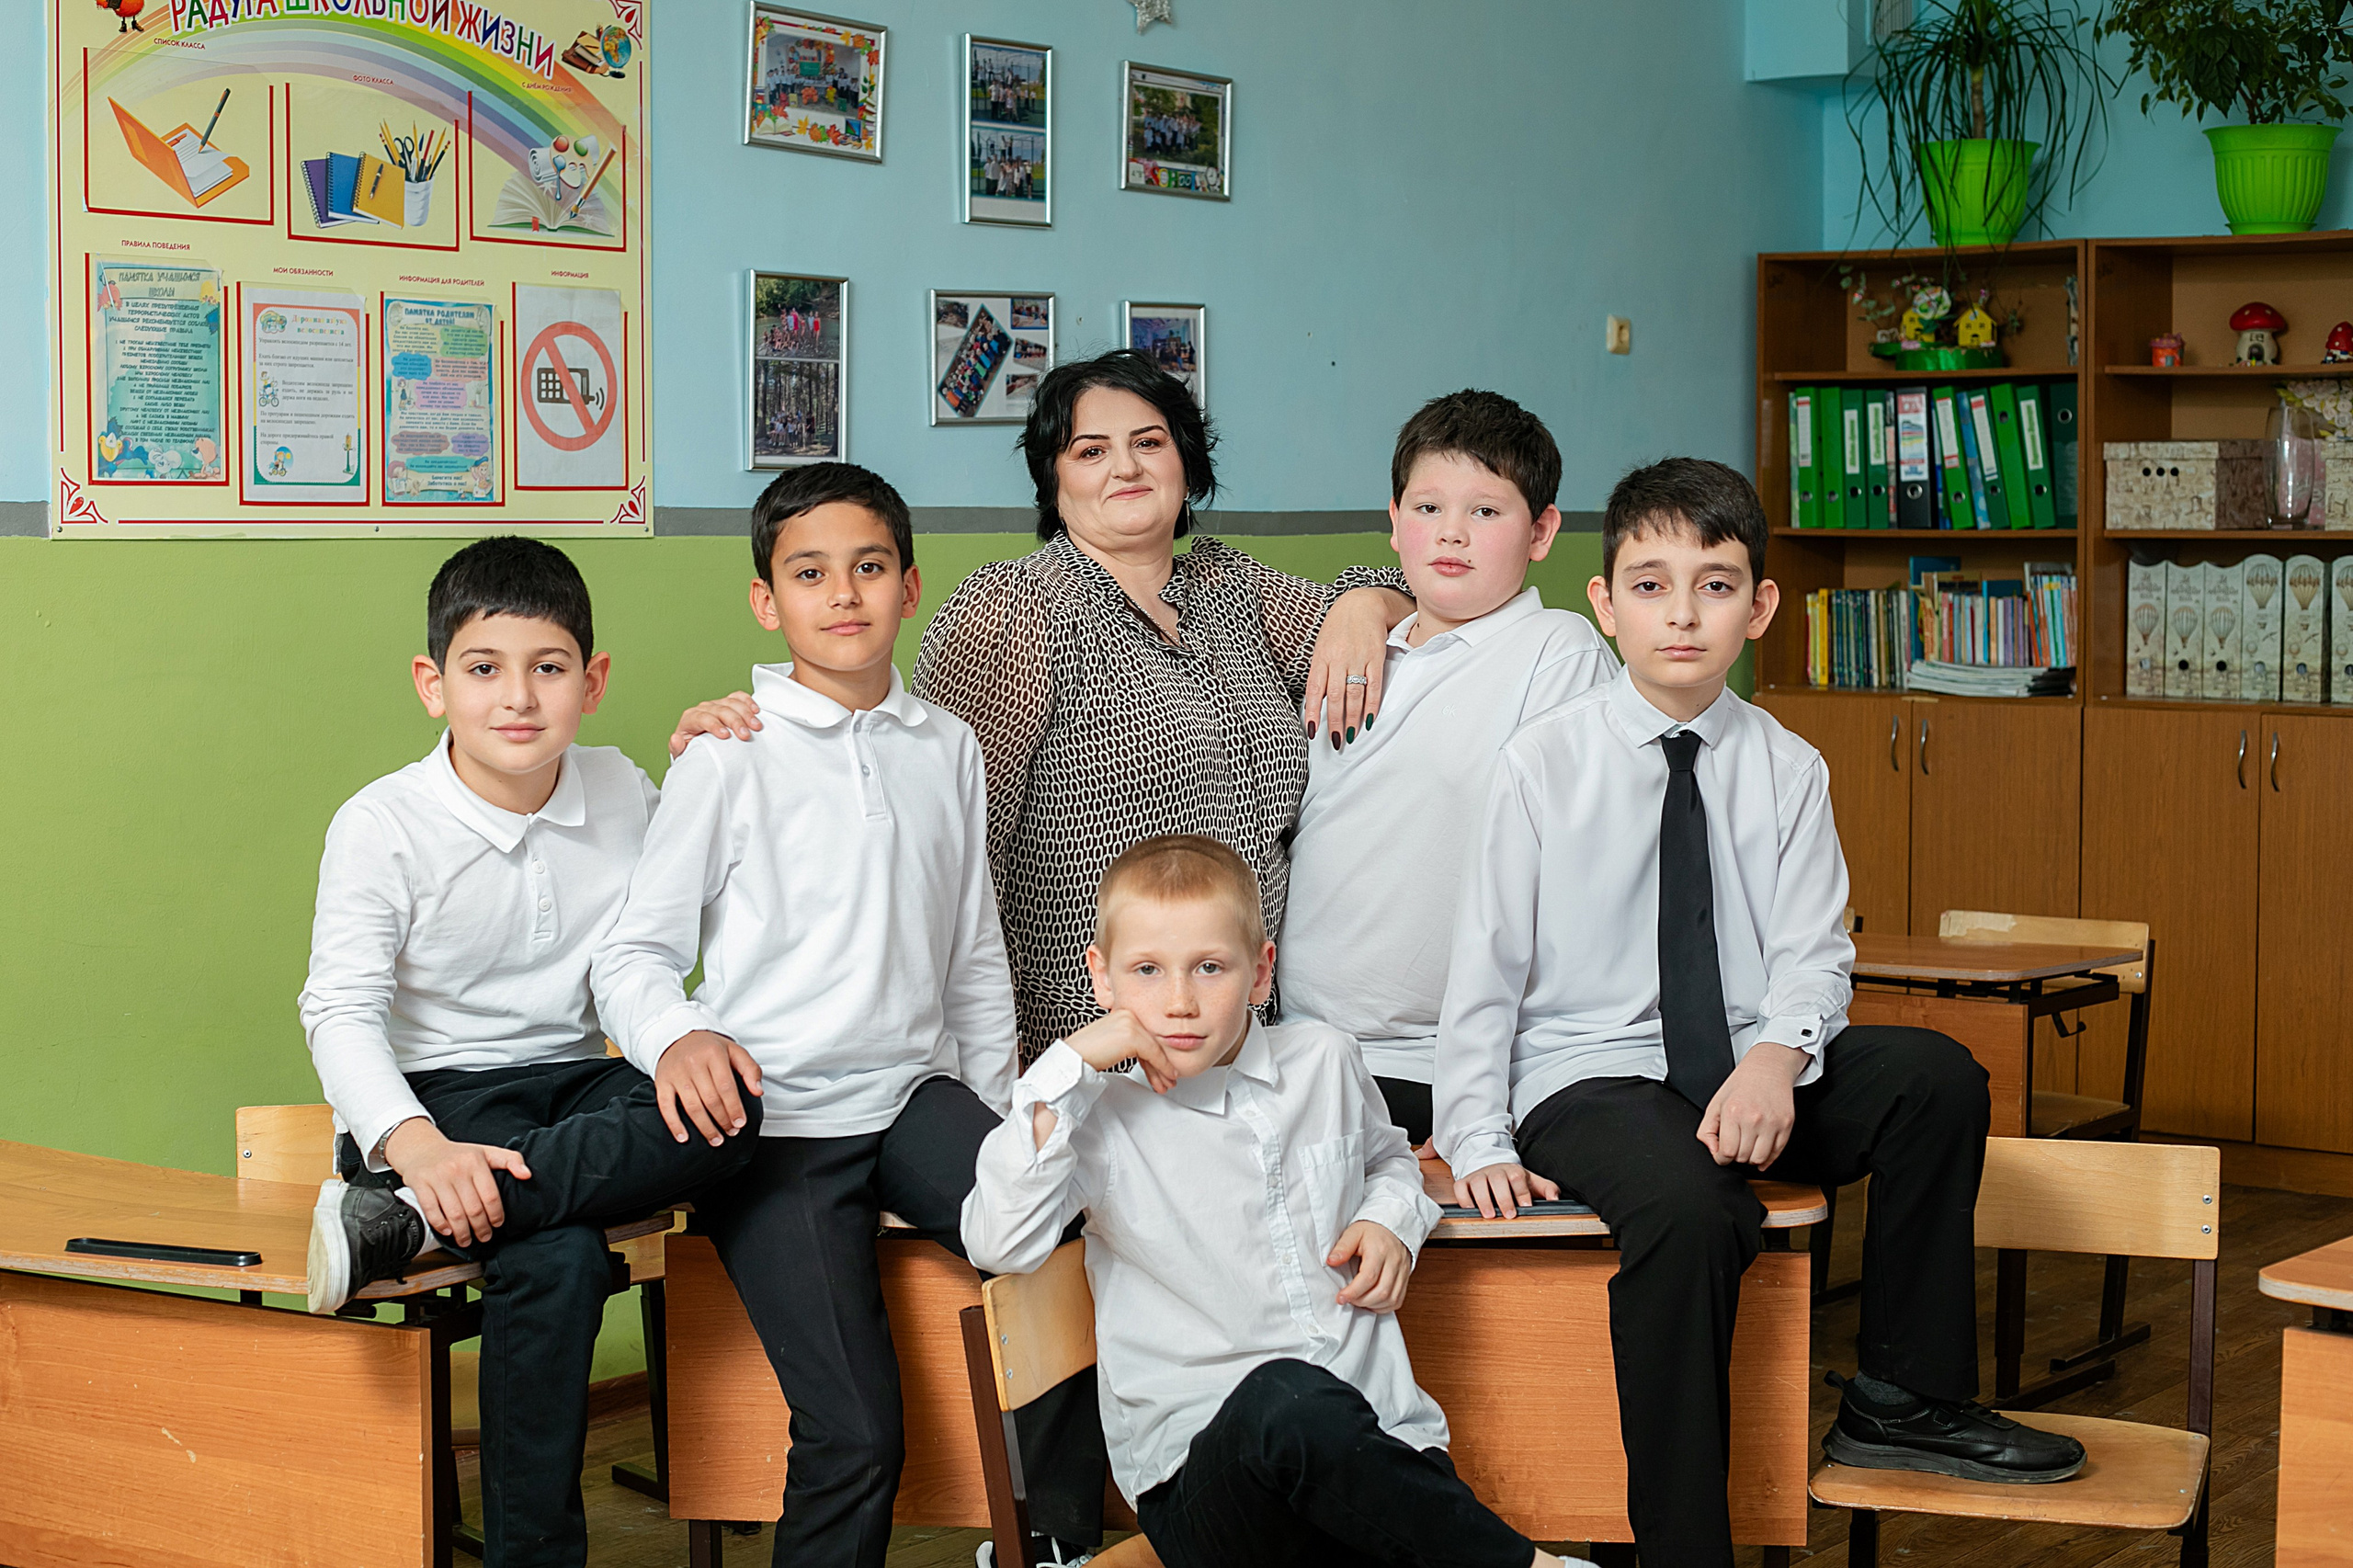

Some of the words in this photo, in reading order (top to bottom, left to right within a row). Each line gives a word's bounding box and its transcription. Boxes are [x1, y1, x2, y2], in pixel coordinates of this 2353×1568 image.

[154, 38, 180, 46] СПИСОК
[457, 4, 555, 77] ЖИЗНИ
[372, 77, 394, 85] КЛАССА
[122, 240, 150, 248] ПРАВИЛА
[152, 242, 190, 250] ПОВЕДЕНИЯ
[289, 267, 333, 276] ОБЯЗАННОСТИ
[119, 272, 153, 282] ПАМЯТКА
[399, 275, 440, 284] ИНФОРМАЦИЯ
[453, 278, 484, 286] РОДИТЕЛЕЙ
[405, 308, 434, 316] ПАМЯТКА
